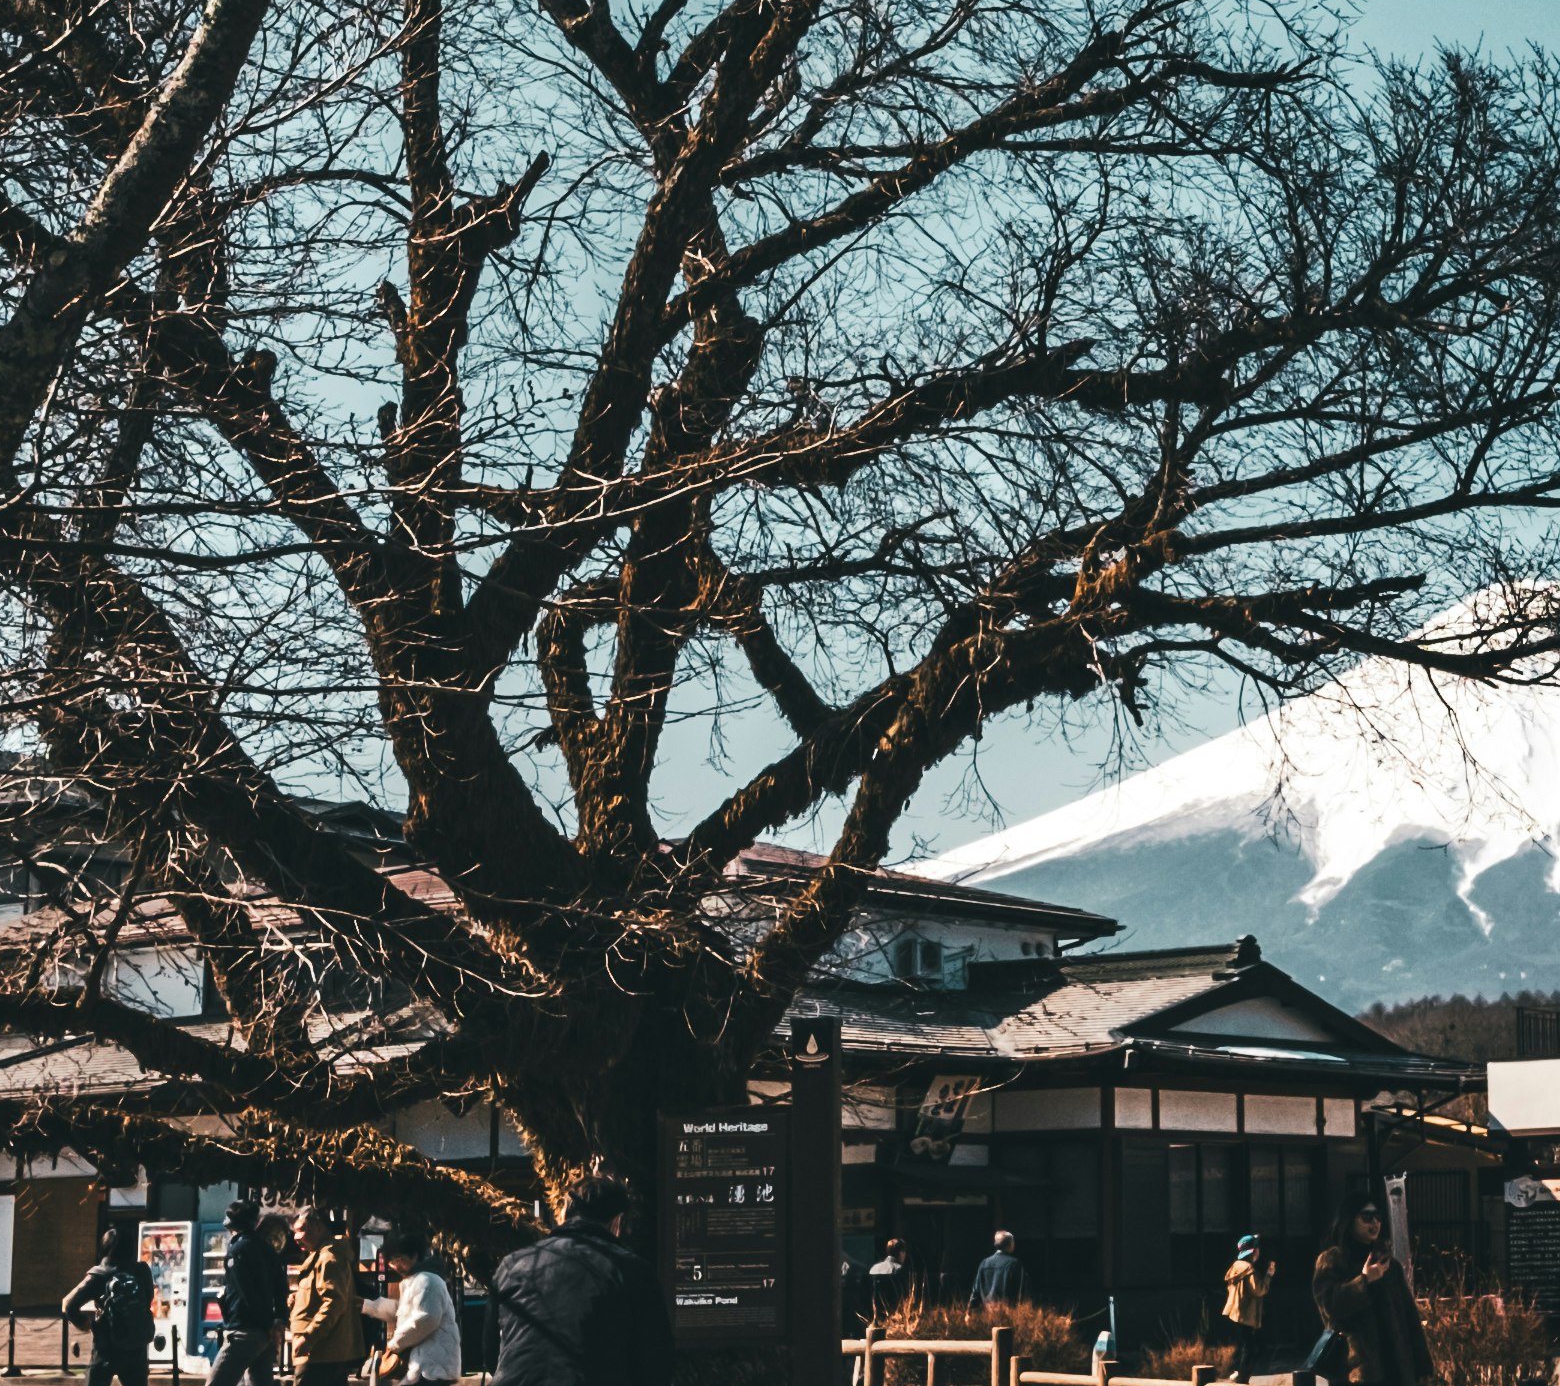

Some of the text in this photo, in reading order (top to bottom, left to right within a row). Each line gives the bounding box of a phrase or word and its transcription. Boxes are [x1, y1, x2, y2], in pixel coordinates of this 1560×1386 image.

[683, 1121, 768, 1133] World Heritage
[762, 1166, 775, 1176] 17
[692, 1265, 703, 1281] 5
[762, 1278, 775, 1288] 17
[715, 1296, 738, 1305] Pond
